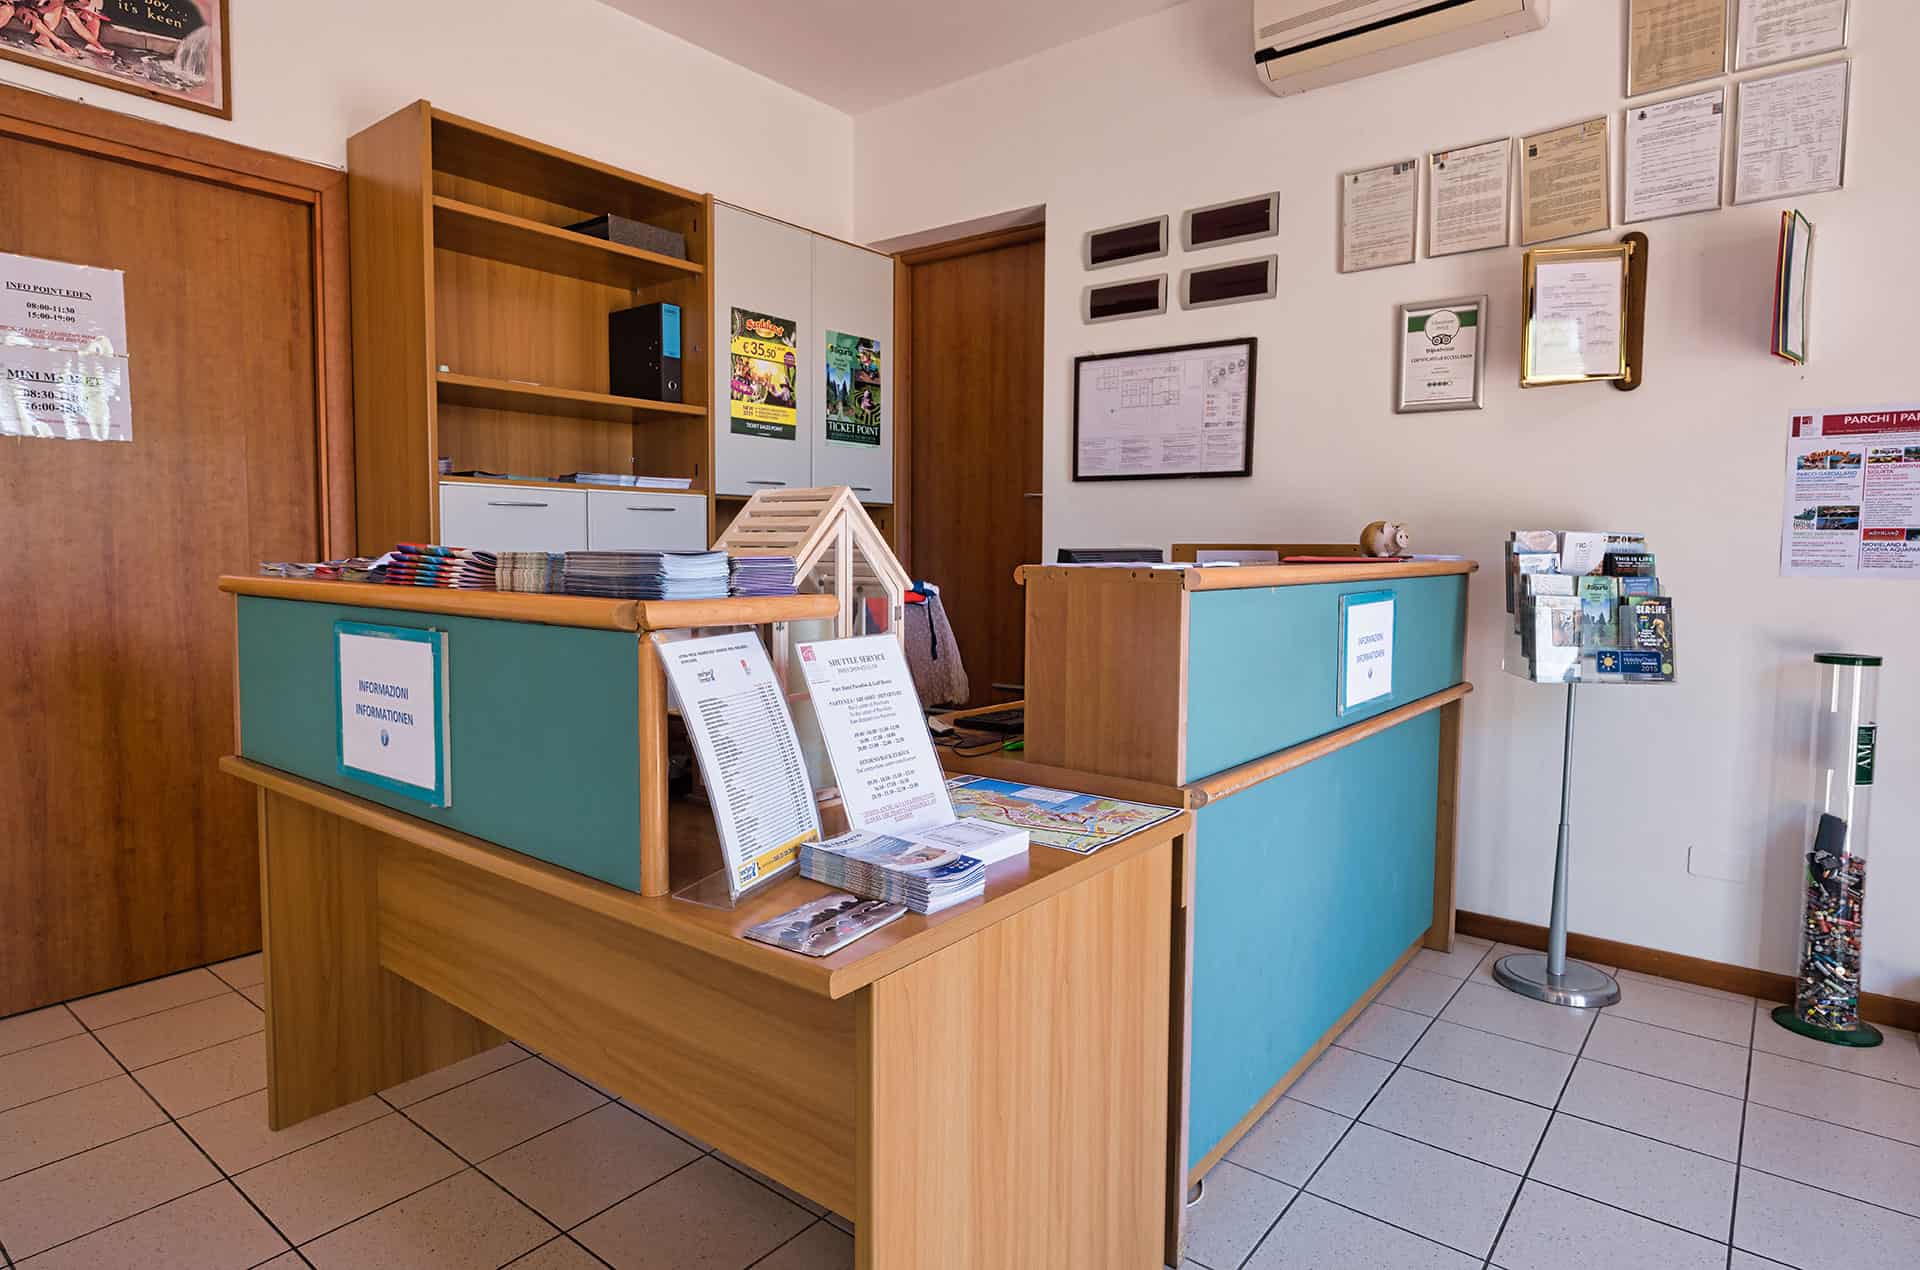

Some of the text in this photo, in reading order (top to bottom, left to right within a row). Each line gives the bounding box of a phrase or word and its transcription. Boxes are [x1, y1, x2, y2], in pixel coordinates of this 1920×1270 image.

[118, 1, 139, 14] it's
[6, 281, 92, 300] INFO POINT EDEN
[7, 369, 40, 380] MINI
[1844, 414, 1890, 424] PARCHI
[828, 421, 880, 437] TICKET POINT
[859, 652, 886, 664] SERVICE
[359, 680, 409, 700] INFORMAZIONI
[356, 704, 413, 726] INFORMATIONEN
